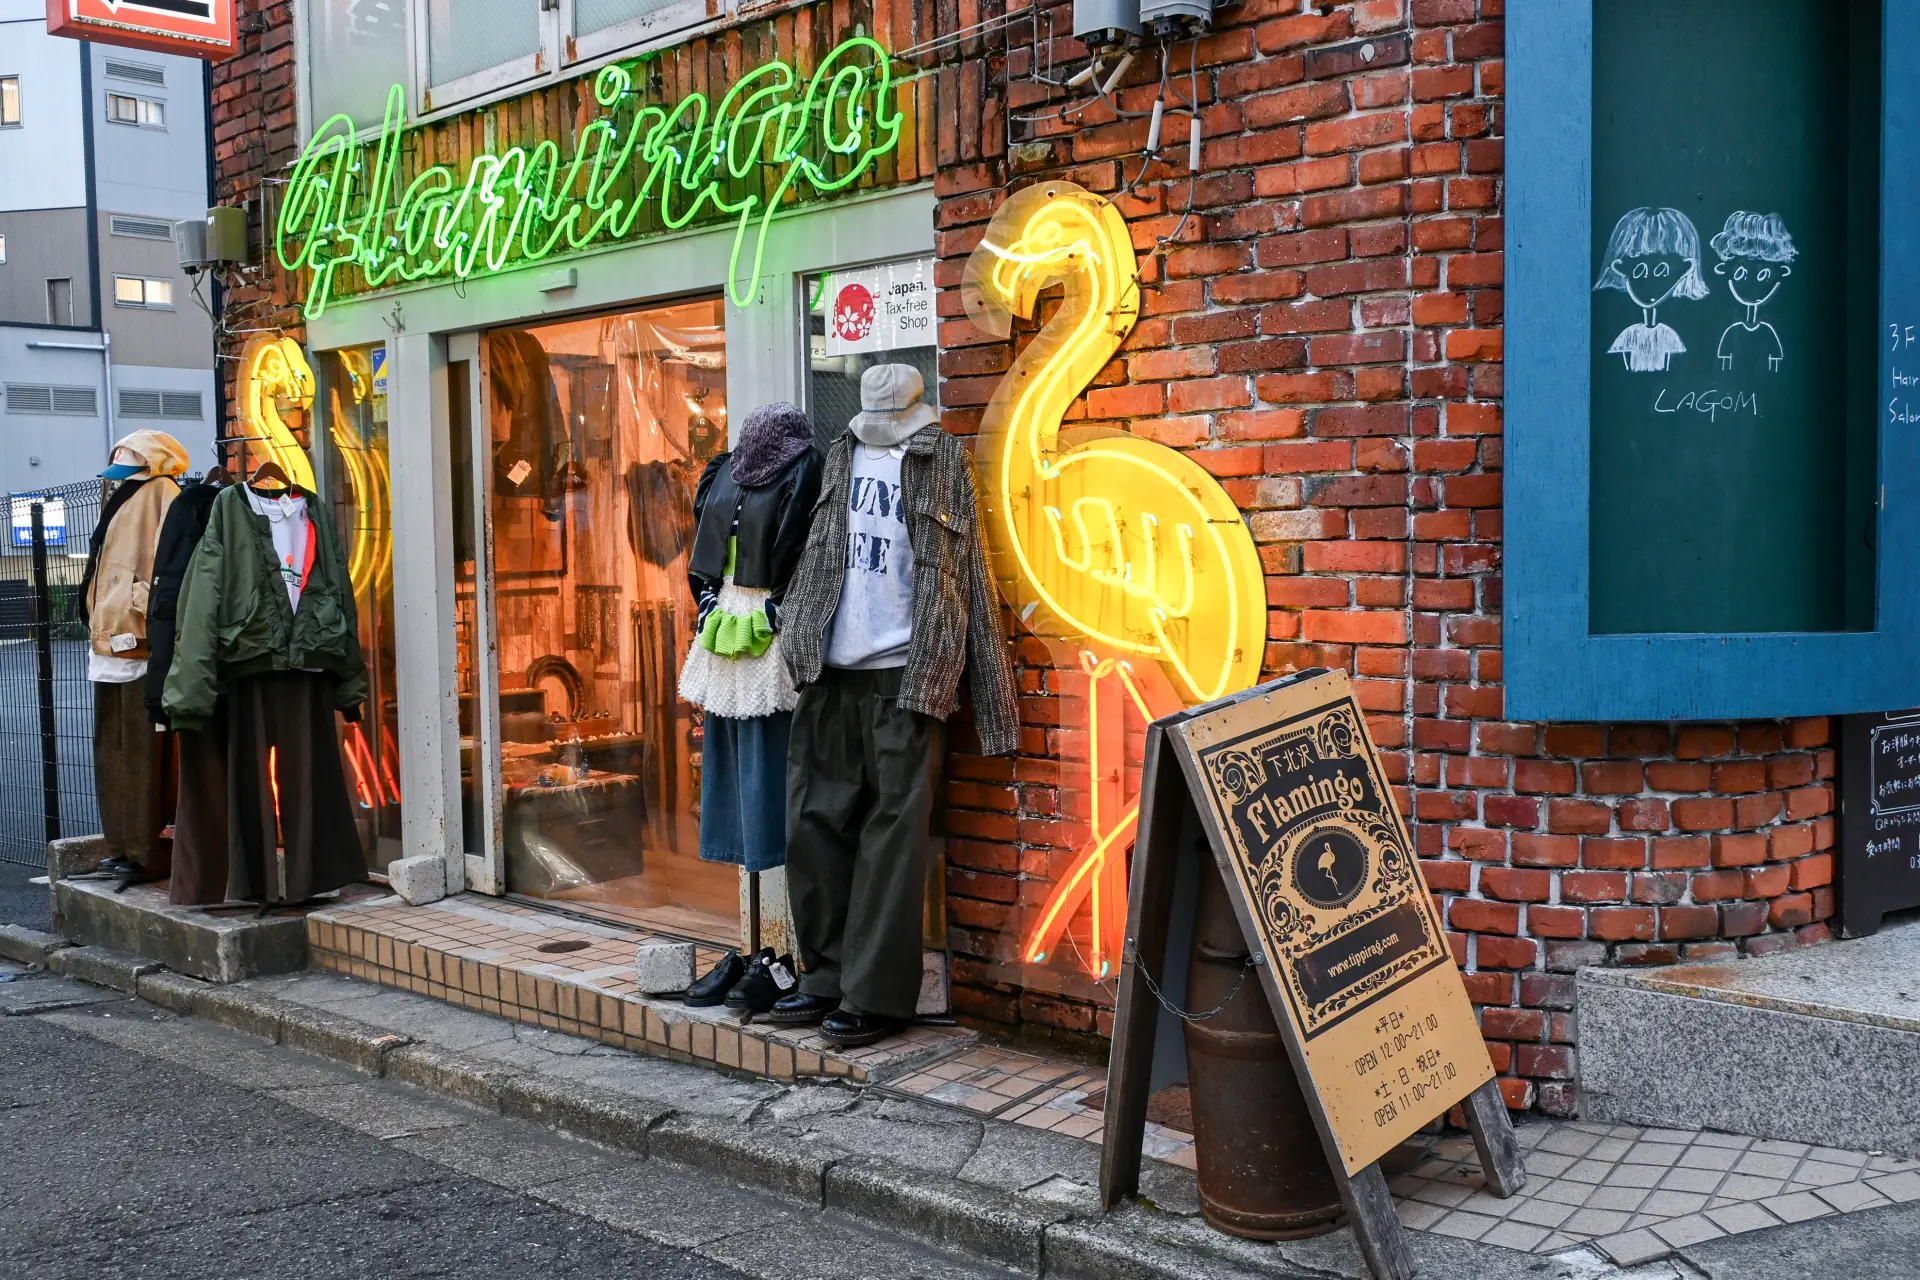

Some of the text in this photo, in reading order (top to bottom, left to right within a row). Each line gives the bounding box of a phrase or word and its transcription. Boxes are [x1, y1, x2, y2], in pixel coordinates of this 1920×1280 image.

[888, 280, 927, 297] Japan.
[884, 299, 928, 315] Tax-free
[900, 316, 928, 331] Shop
[1892, 366, 1919, 388] Hair
[1267, 744, 1314, 777] 下北沢
[1247, 769, 1364, 845] Flamingo
[1327, 933, 1399, 978] www.tippirag.com
[1354, 1050, 1379, 1076] OPEN
[1374, 1101, 1398, 1127] OPEN
